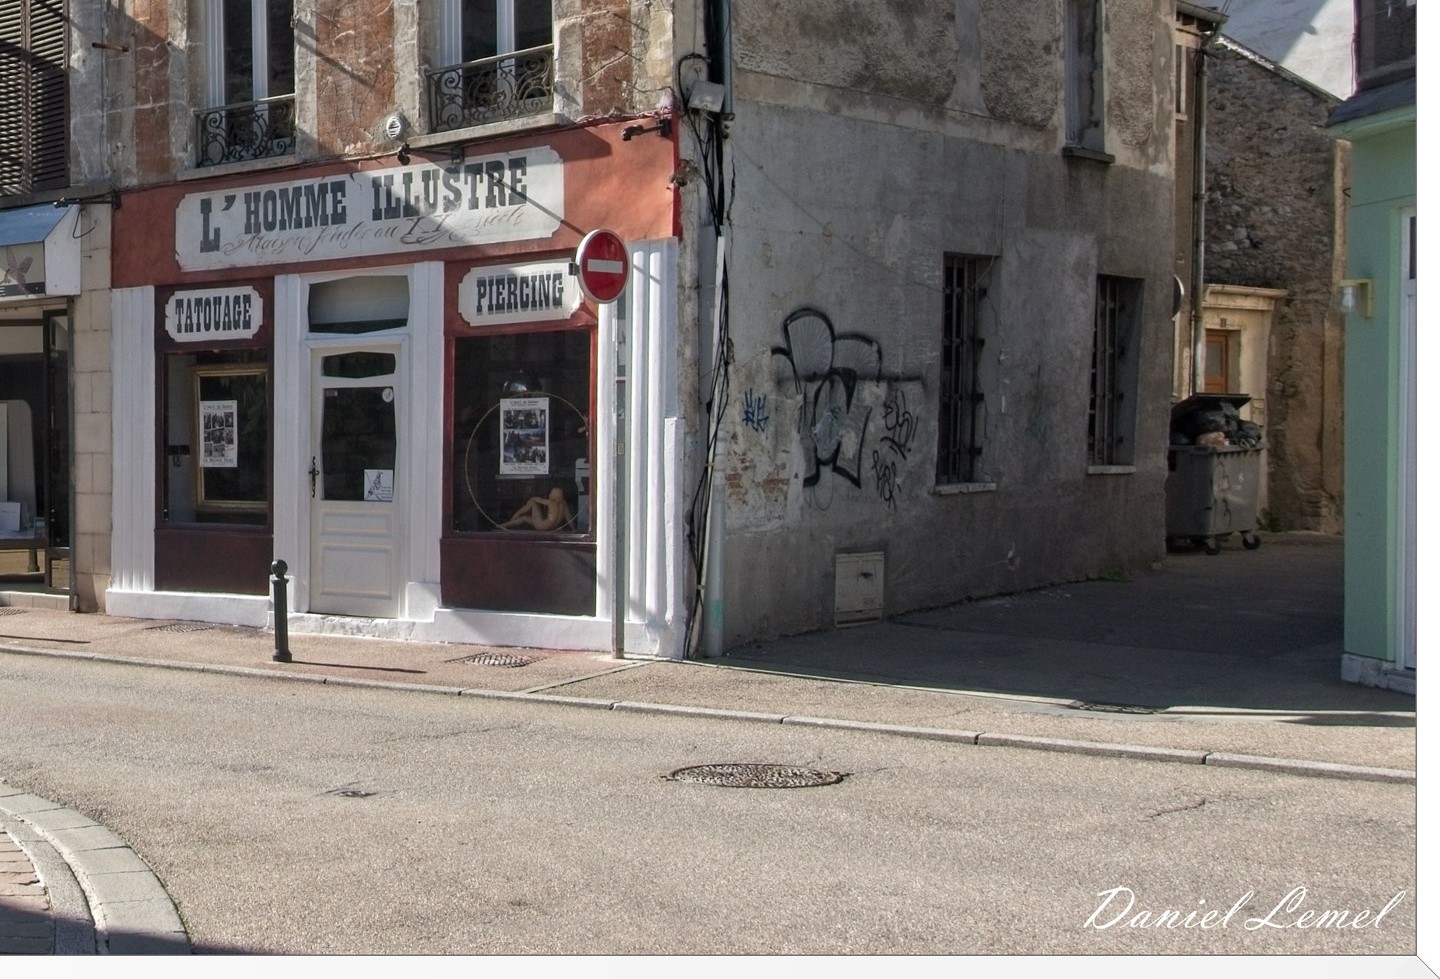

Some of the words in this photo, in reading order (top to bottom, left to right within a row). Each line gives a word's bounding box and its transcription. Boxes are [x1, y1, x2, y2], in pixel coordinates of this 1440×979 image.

[370, 156, 529, 219] ILLUSTRE
[174, 293, 252, 334] TATOUAGE
[475, 272, 565, 314] PIERCING
